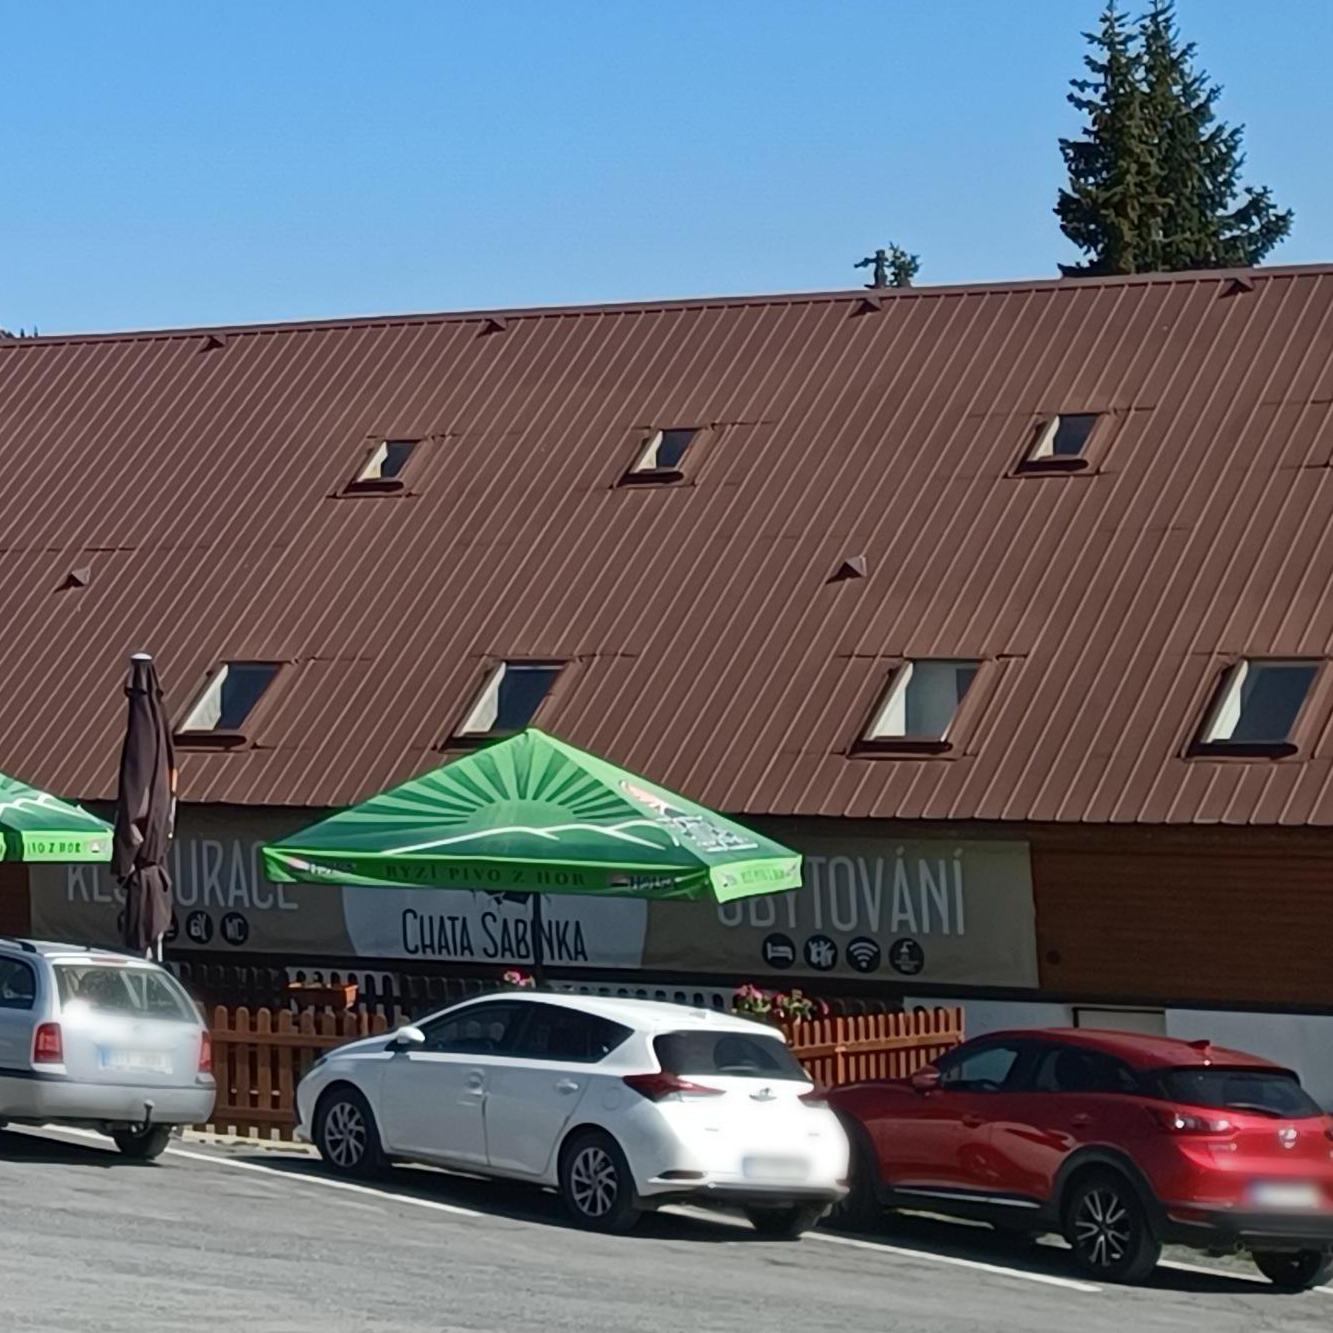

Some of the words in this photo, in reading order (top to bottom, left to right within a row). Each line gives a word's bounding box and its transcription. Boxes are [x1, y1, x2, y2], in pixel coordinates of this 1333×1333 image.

[448, 867, 501, 883] PIVO
[512, 869, 525, 883] Z
[536, 871, 586, 886] HOR
[402, 908, 475, 957] CHATA
